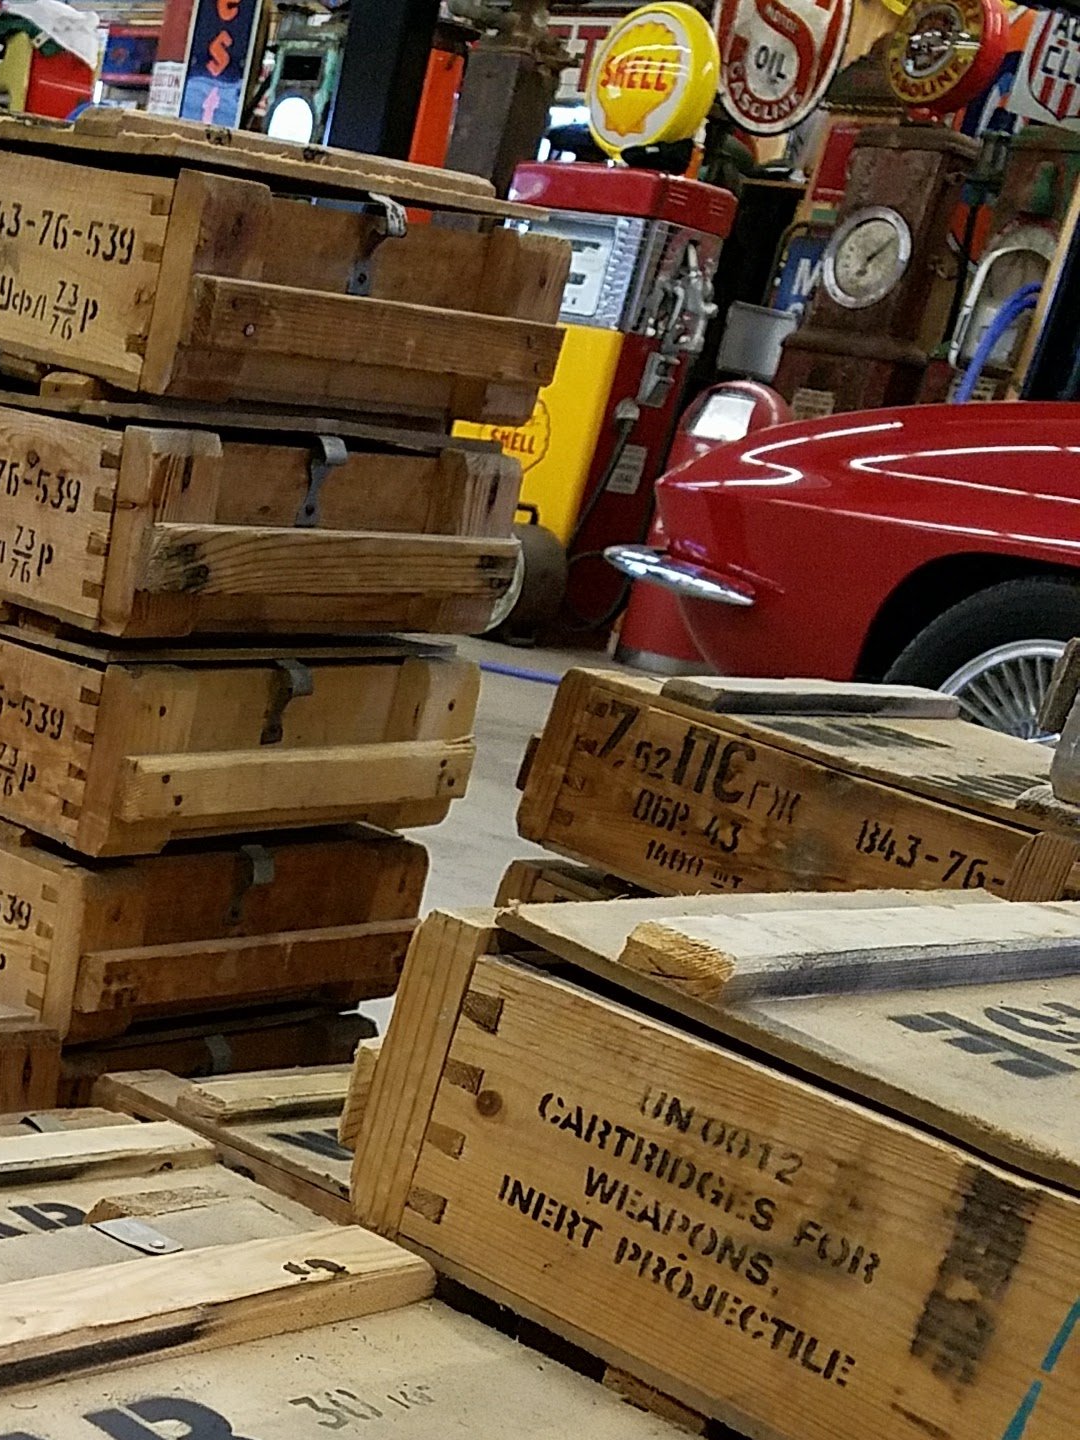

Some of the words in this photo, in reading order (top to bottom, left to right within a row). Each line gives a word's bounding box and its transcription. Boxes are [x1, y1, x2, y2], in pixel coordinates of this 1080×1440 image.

[600, 54, 667, 91] SHELL
[754, 45, 787, 80] OIL
[490, 428, 536, 455] SHELL
[538, 1093, 776, 1231] CARTRIDGES
[793, 1219, 880, 1284] FOR
[497, 1174, 603, 1248] INERT
[614, 1236, 856, 1387] PROJECTILE
